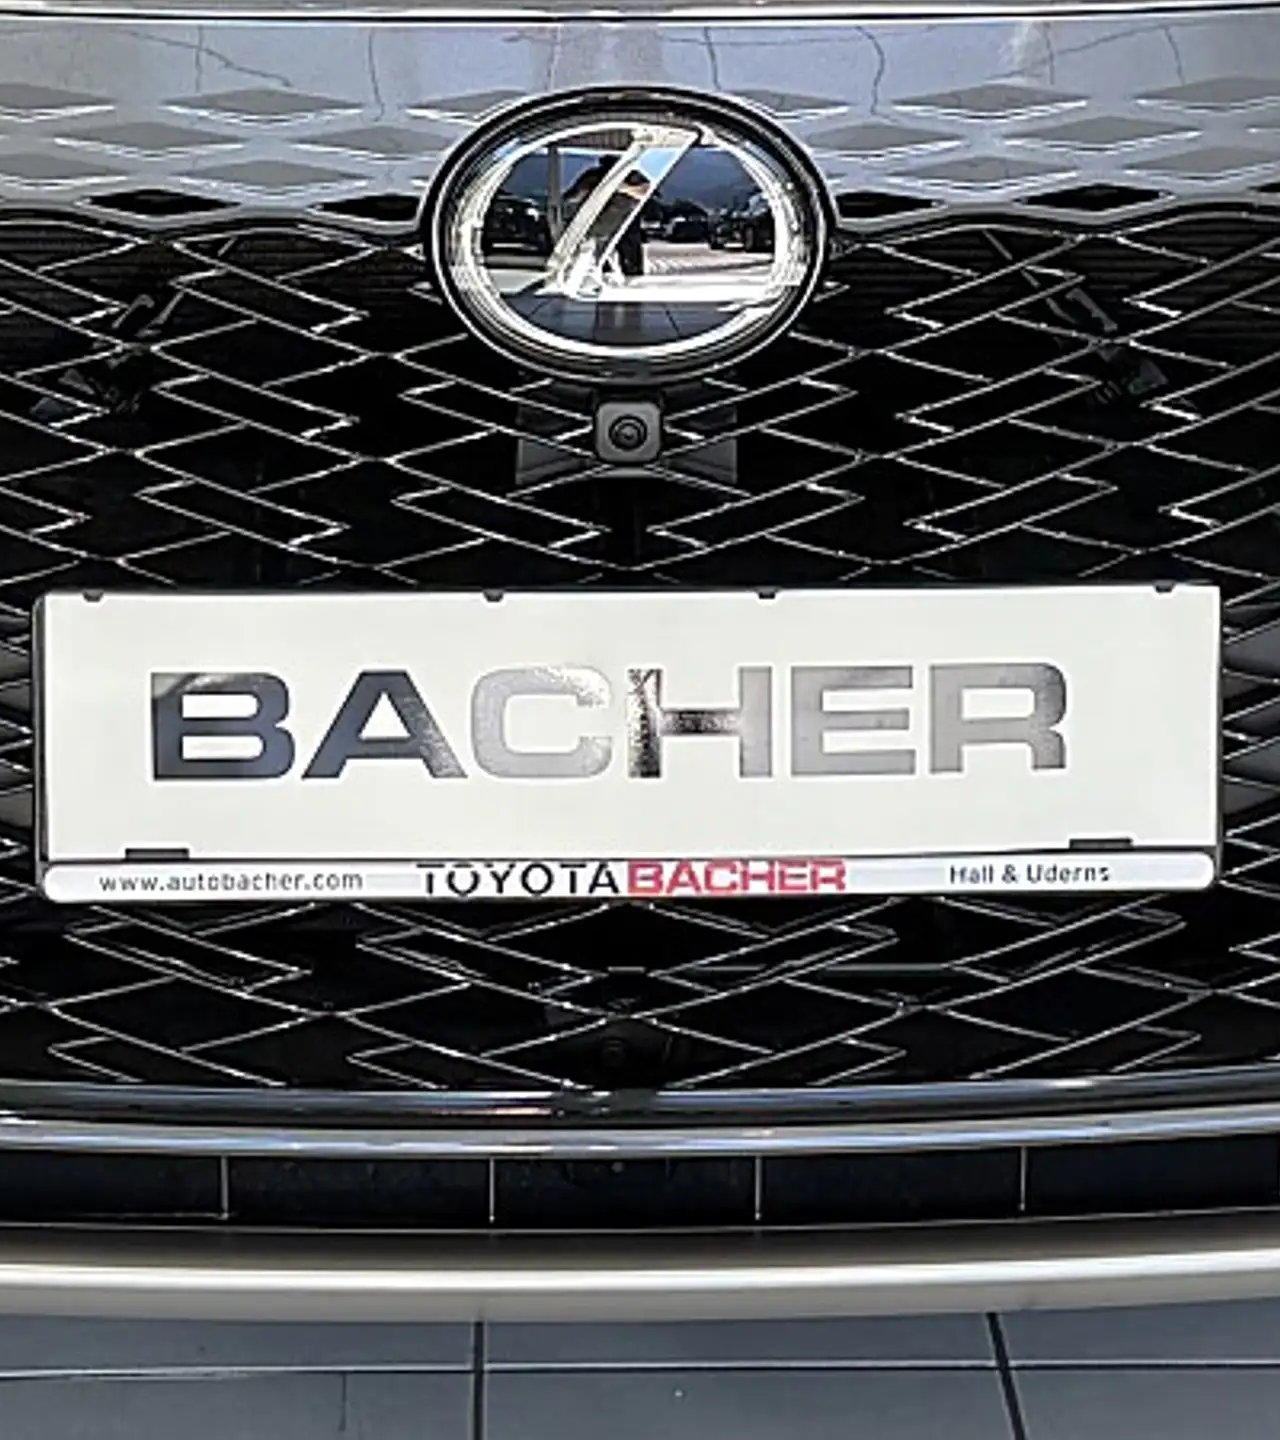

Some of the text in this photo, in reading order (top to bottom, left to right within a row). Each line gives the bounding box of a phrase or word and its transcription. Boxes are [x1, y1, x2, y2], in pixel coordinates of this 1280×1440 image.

[149, 662, 1067, 782] BACHER
[98, 870, 364, 892] www.autobacher.com
[949, 863, 994, 885] Hall
[1000, 863, 1018, 884] &
